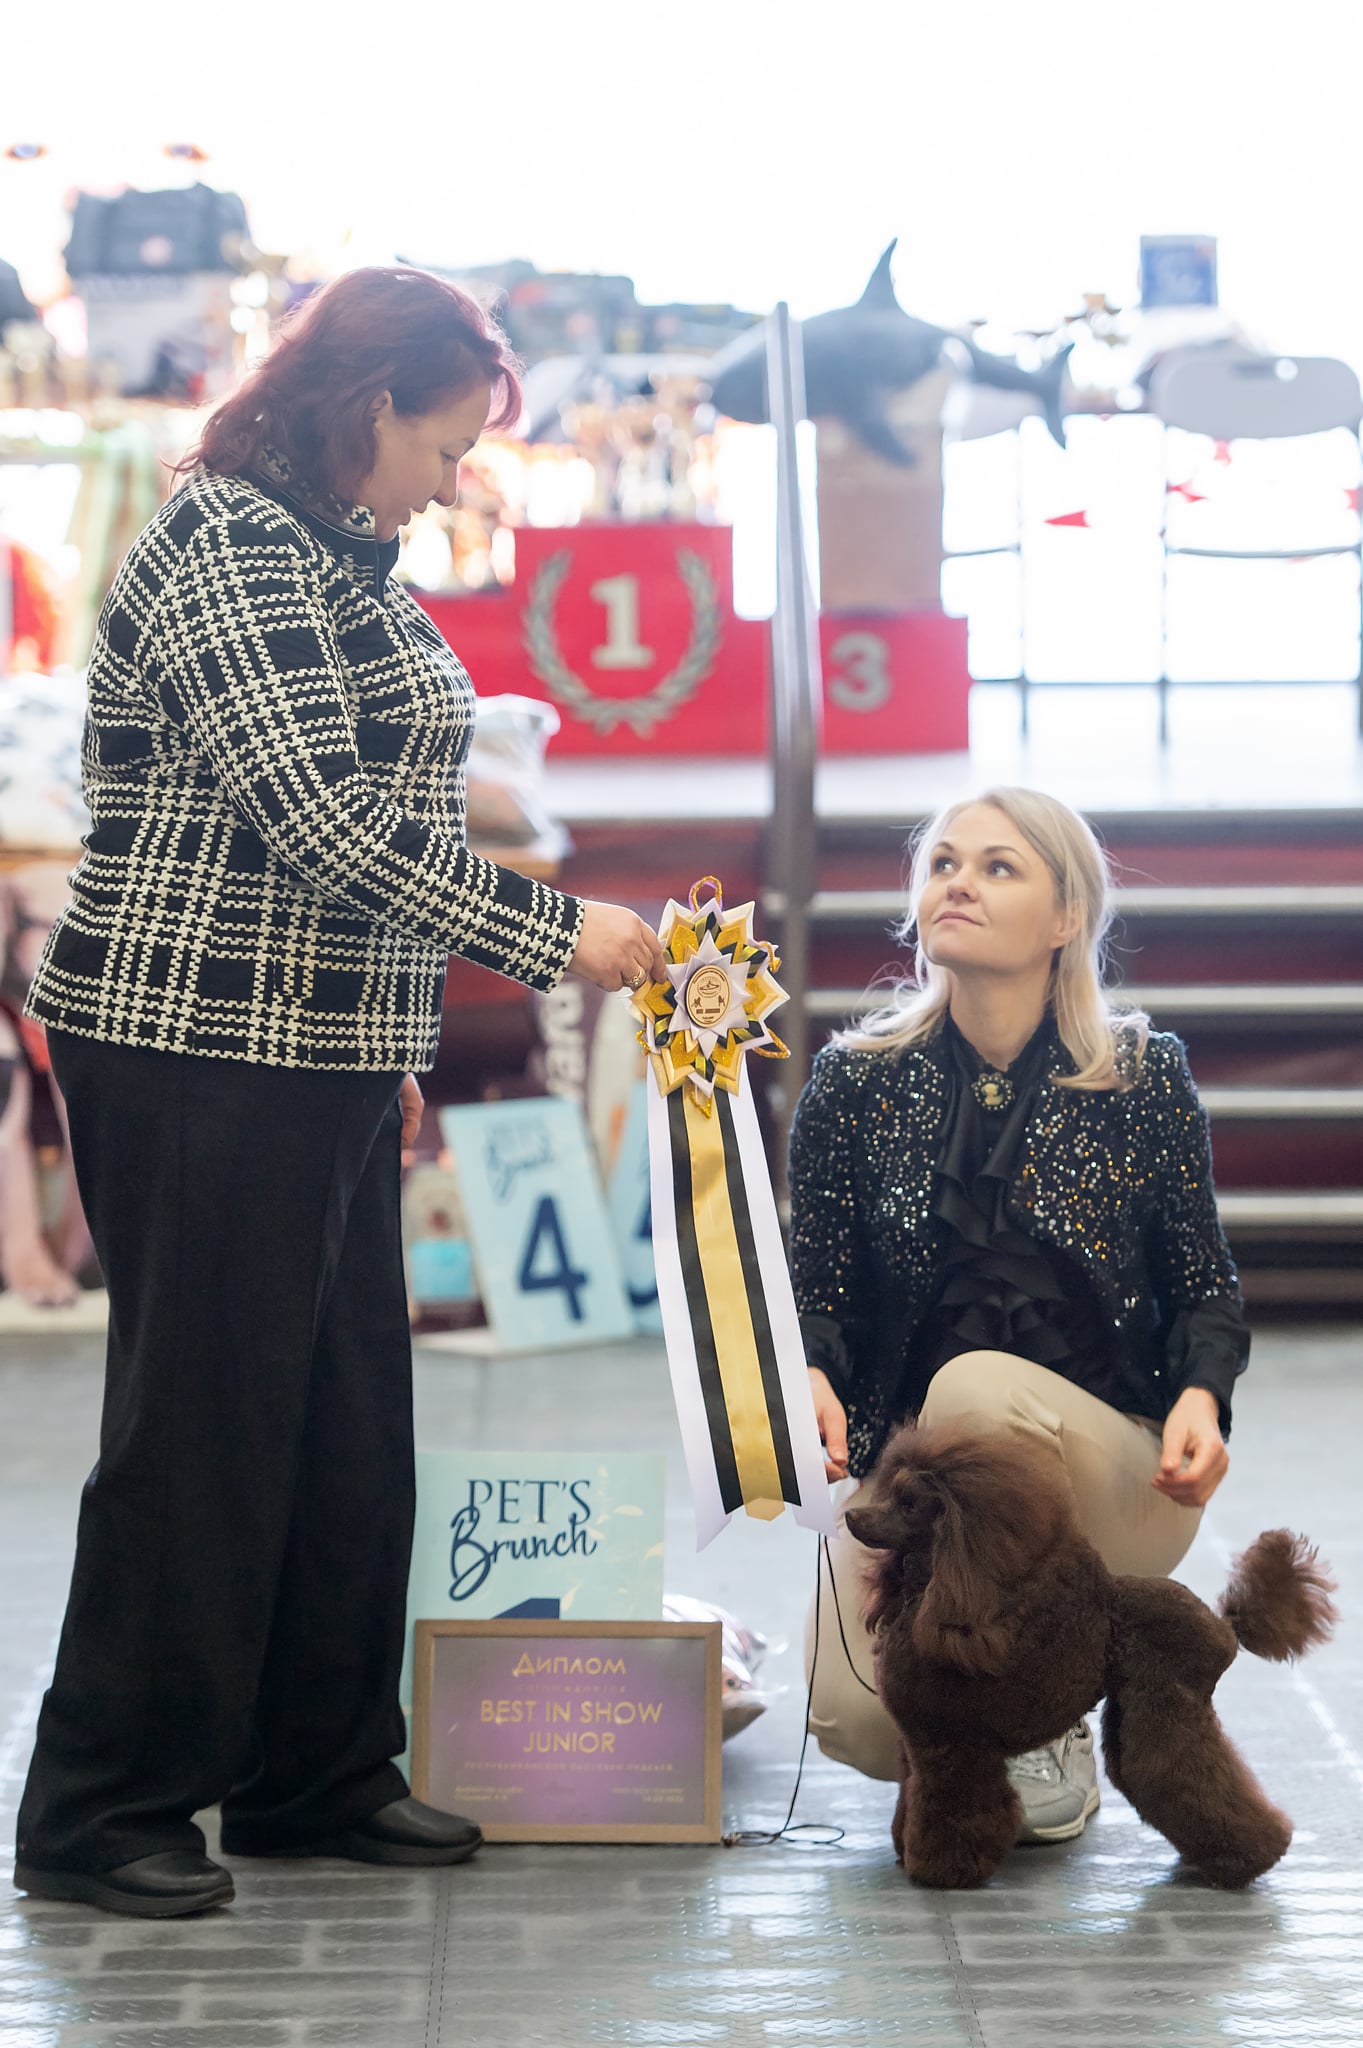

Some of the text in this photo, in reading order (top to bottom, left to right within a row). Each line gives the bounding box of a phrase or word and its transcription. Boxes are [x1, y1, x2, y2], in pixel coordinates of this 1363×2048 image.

[590, 574, 655, 669] 1
[828, 631, 892, 713] 3
[518, 1196, 588, 1324] 4
[467, 1479, 591, 1524] PET'S
[449, 1505, 598, 1601] Brunch
[480, 1700, 663, 1724] BEST IN SHOW
[523, 1732, 616, 1753] JUNIOR
